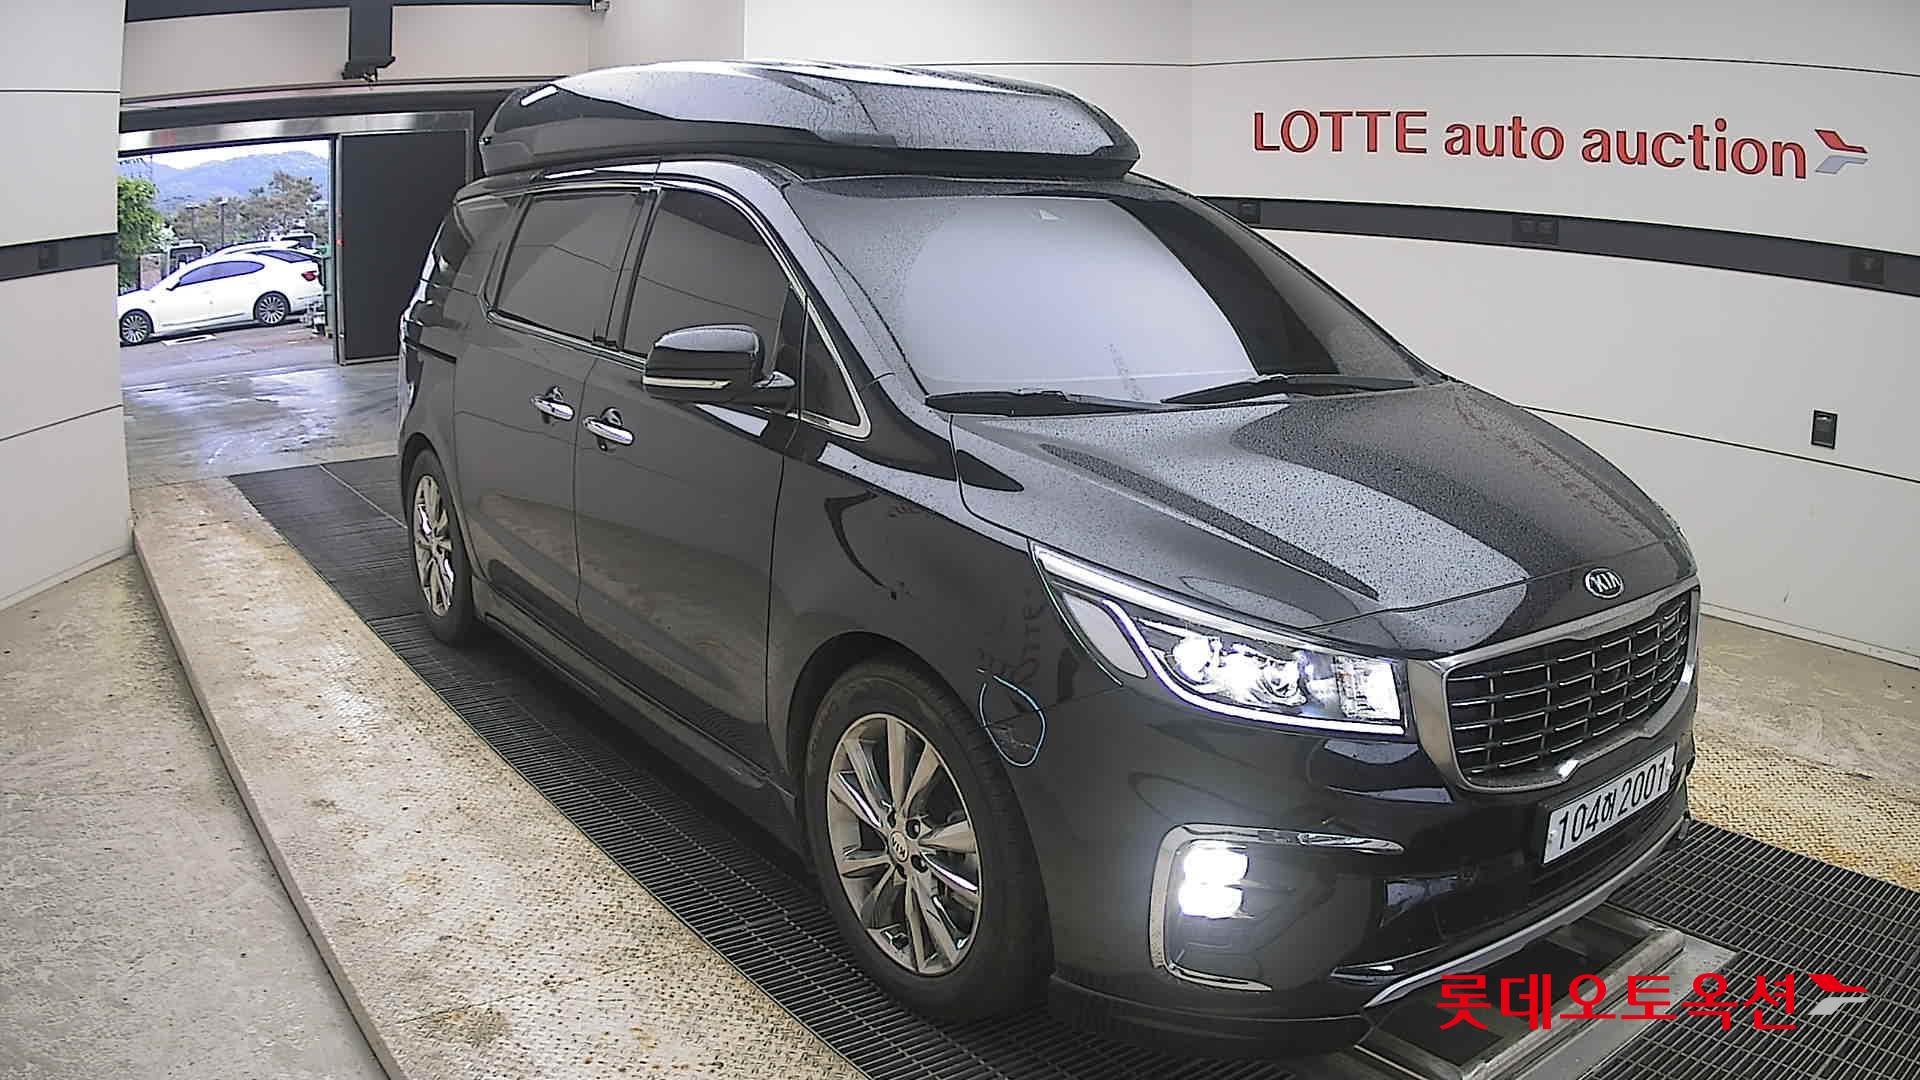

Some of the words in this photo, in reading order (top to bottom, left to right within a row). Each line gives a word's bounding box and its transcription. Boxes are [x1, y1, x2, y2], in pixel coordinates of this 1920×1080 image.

[1253, 110, 1428, 154] LOTTE
[1444, 115, 1565, 160] auto
[1581, 117, 1807, 179] auction
[1590, 571, 1621, 593] KIA
